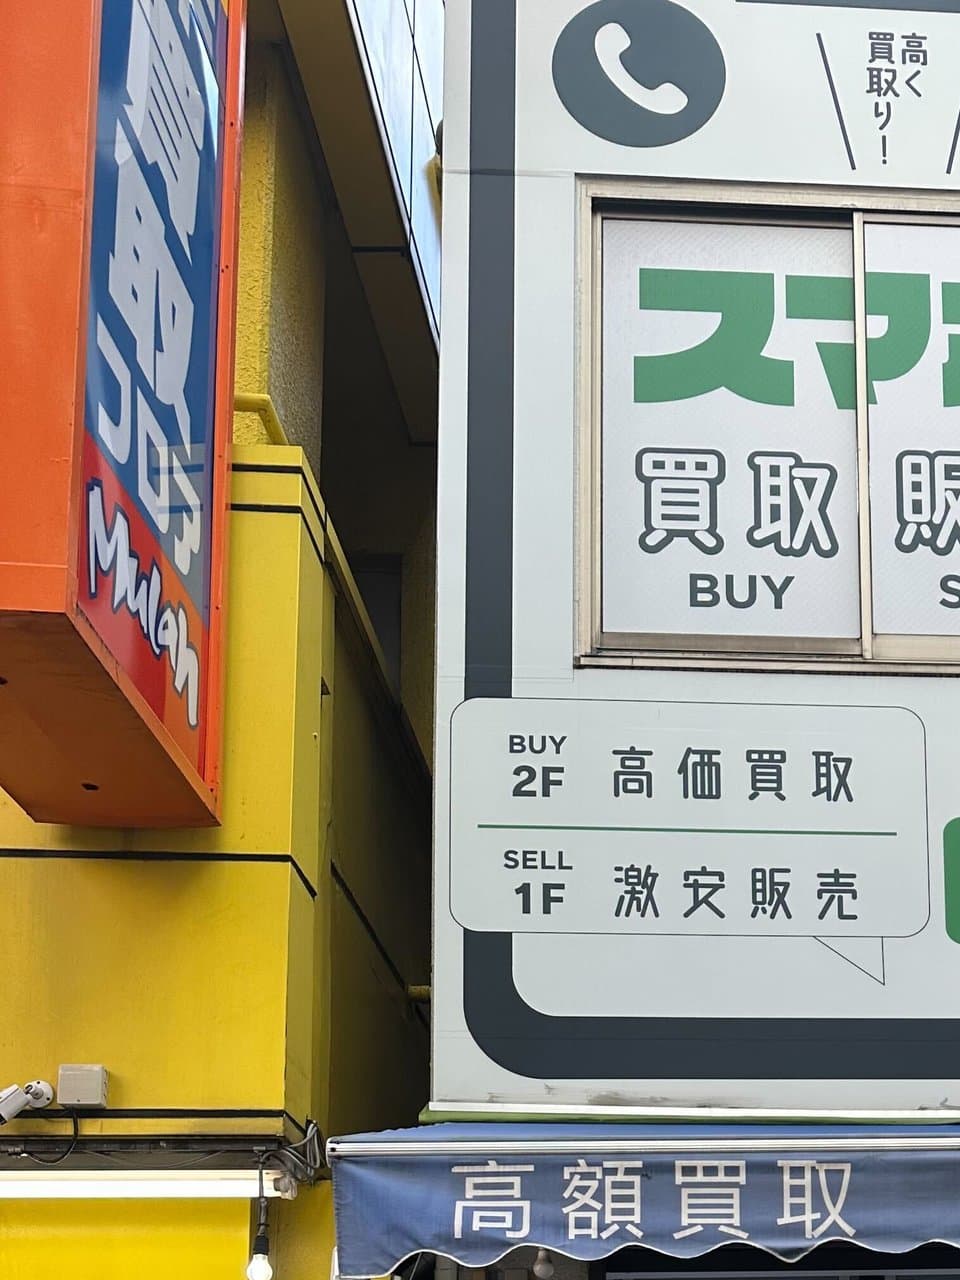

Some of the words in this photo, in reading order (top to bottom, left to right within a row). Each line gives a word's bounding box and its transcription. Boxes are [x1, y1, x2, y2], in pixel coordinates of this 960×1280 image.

[901, 32, 927, 98] 高く
[634, 447, 839, 558] 買取
[87, 478, 200, 731] Mulan
[688, 573, 795, 611] BUY
[508, 734, 568, 755] BUY
[512, 765, 565, 798] 2F
[612, 746, 854, 803] 高価買取
[503, 850, 573, 870] SELL
[514, 882, 565, 915] 1F
[614, 864, 860, 921] 激安販売
[451, 1158, 856, 1241] 高額買取
